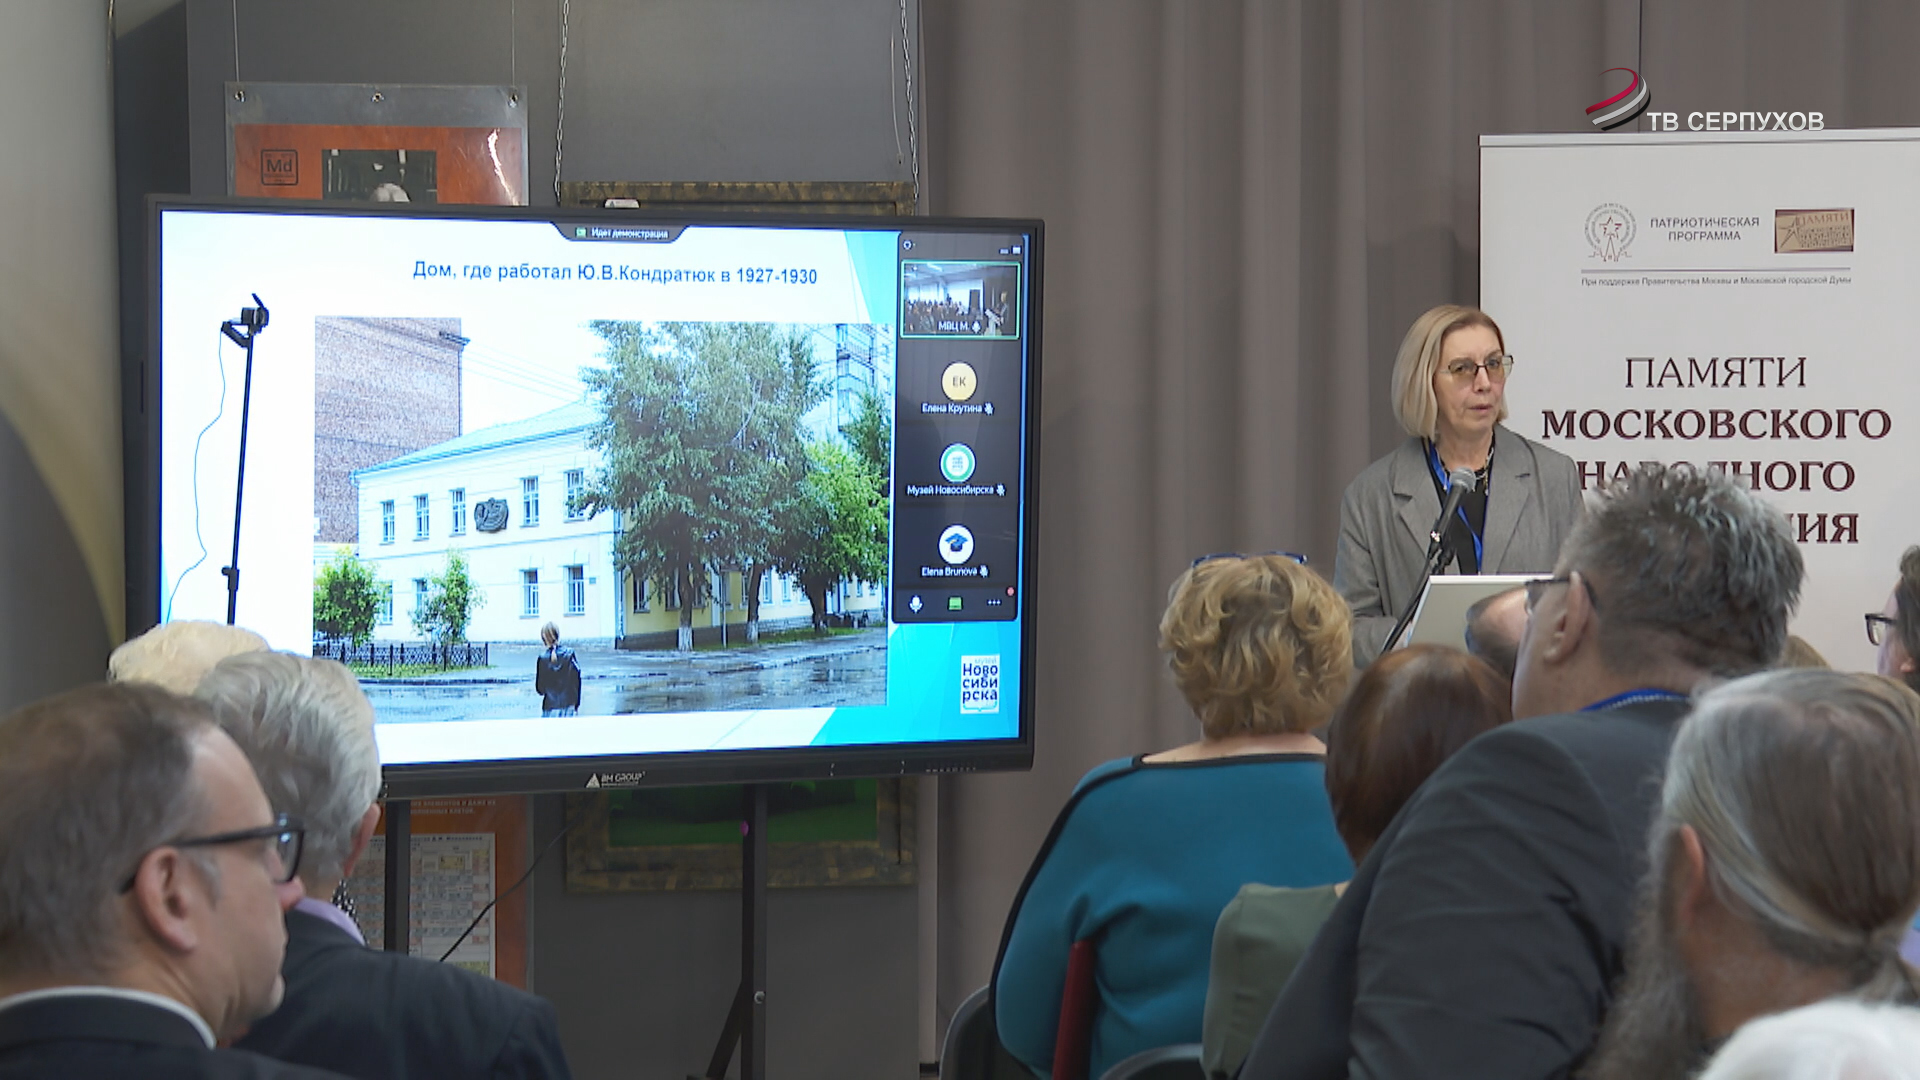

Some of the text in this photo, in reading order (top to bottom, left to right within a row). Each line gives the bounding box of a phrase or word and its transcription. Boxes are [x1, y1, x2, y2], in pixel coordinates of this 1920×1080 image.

[267, 159, 292, 172] Md
[1650, 216, 1760, 228] ПАТРИОТИЧЕСКАЯ
[612, 229, 669, 239] демонстрация
[1668, 231, 1741, 241] ПРОГРАММА
[413, 261, 817, 285] Дом, где работал Ю.В.Кондратюк в 1927-1930
[1581, 277, 1597, 287] При
[1599, 279, 1640, 287] поддержке
[1642, 277, 1700, 287] Правительства
[1702, 277, 1732, 285] Москвы
[1741, 276, 1786, 285] Московской
[1788, 277, 1828, 286] городской
[1829, 275, 1852, 286] Думы
[1625, 357, 1807, 388] ПАМЯТИ
[922, 402, 983, 415] Елена Крутина
[1541, 408, 1892, 440] МОСКОВСКОГО
[907, 484, 994, 497] Музей Новосибирска
[922, 567, 978, 577] Elena Brunova
[963, 663, 998, 676] Ново
[963, 677, 998, 688] сиби
[963, 690, 998, 704] рска
